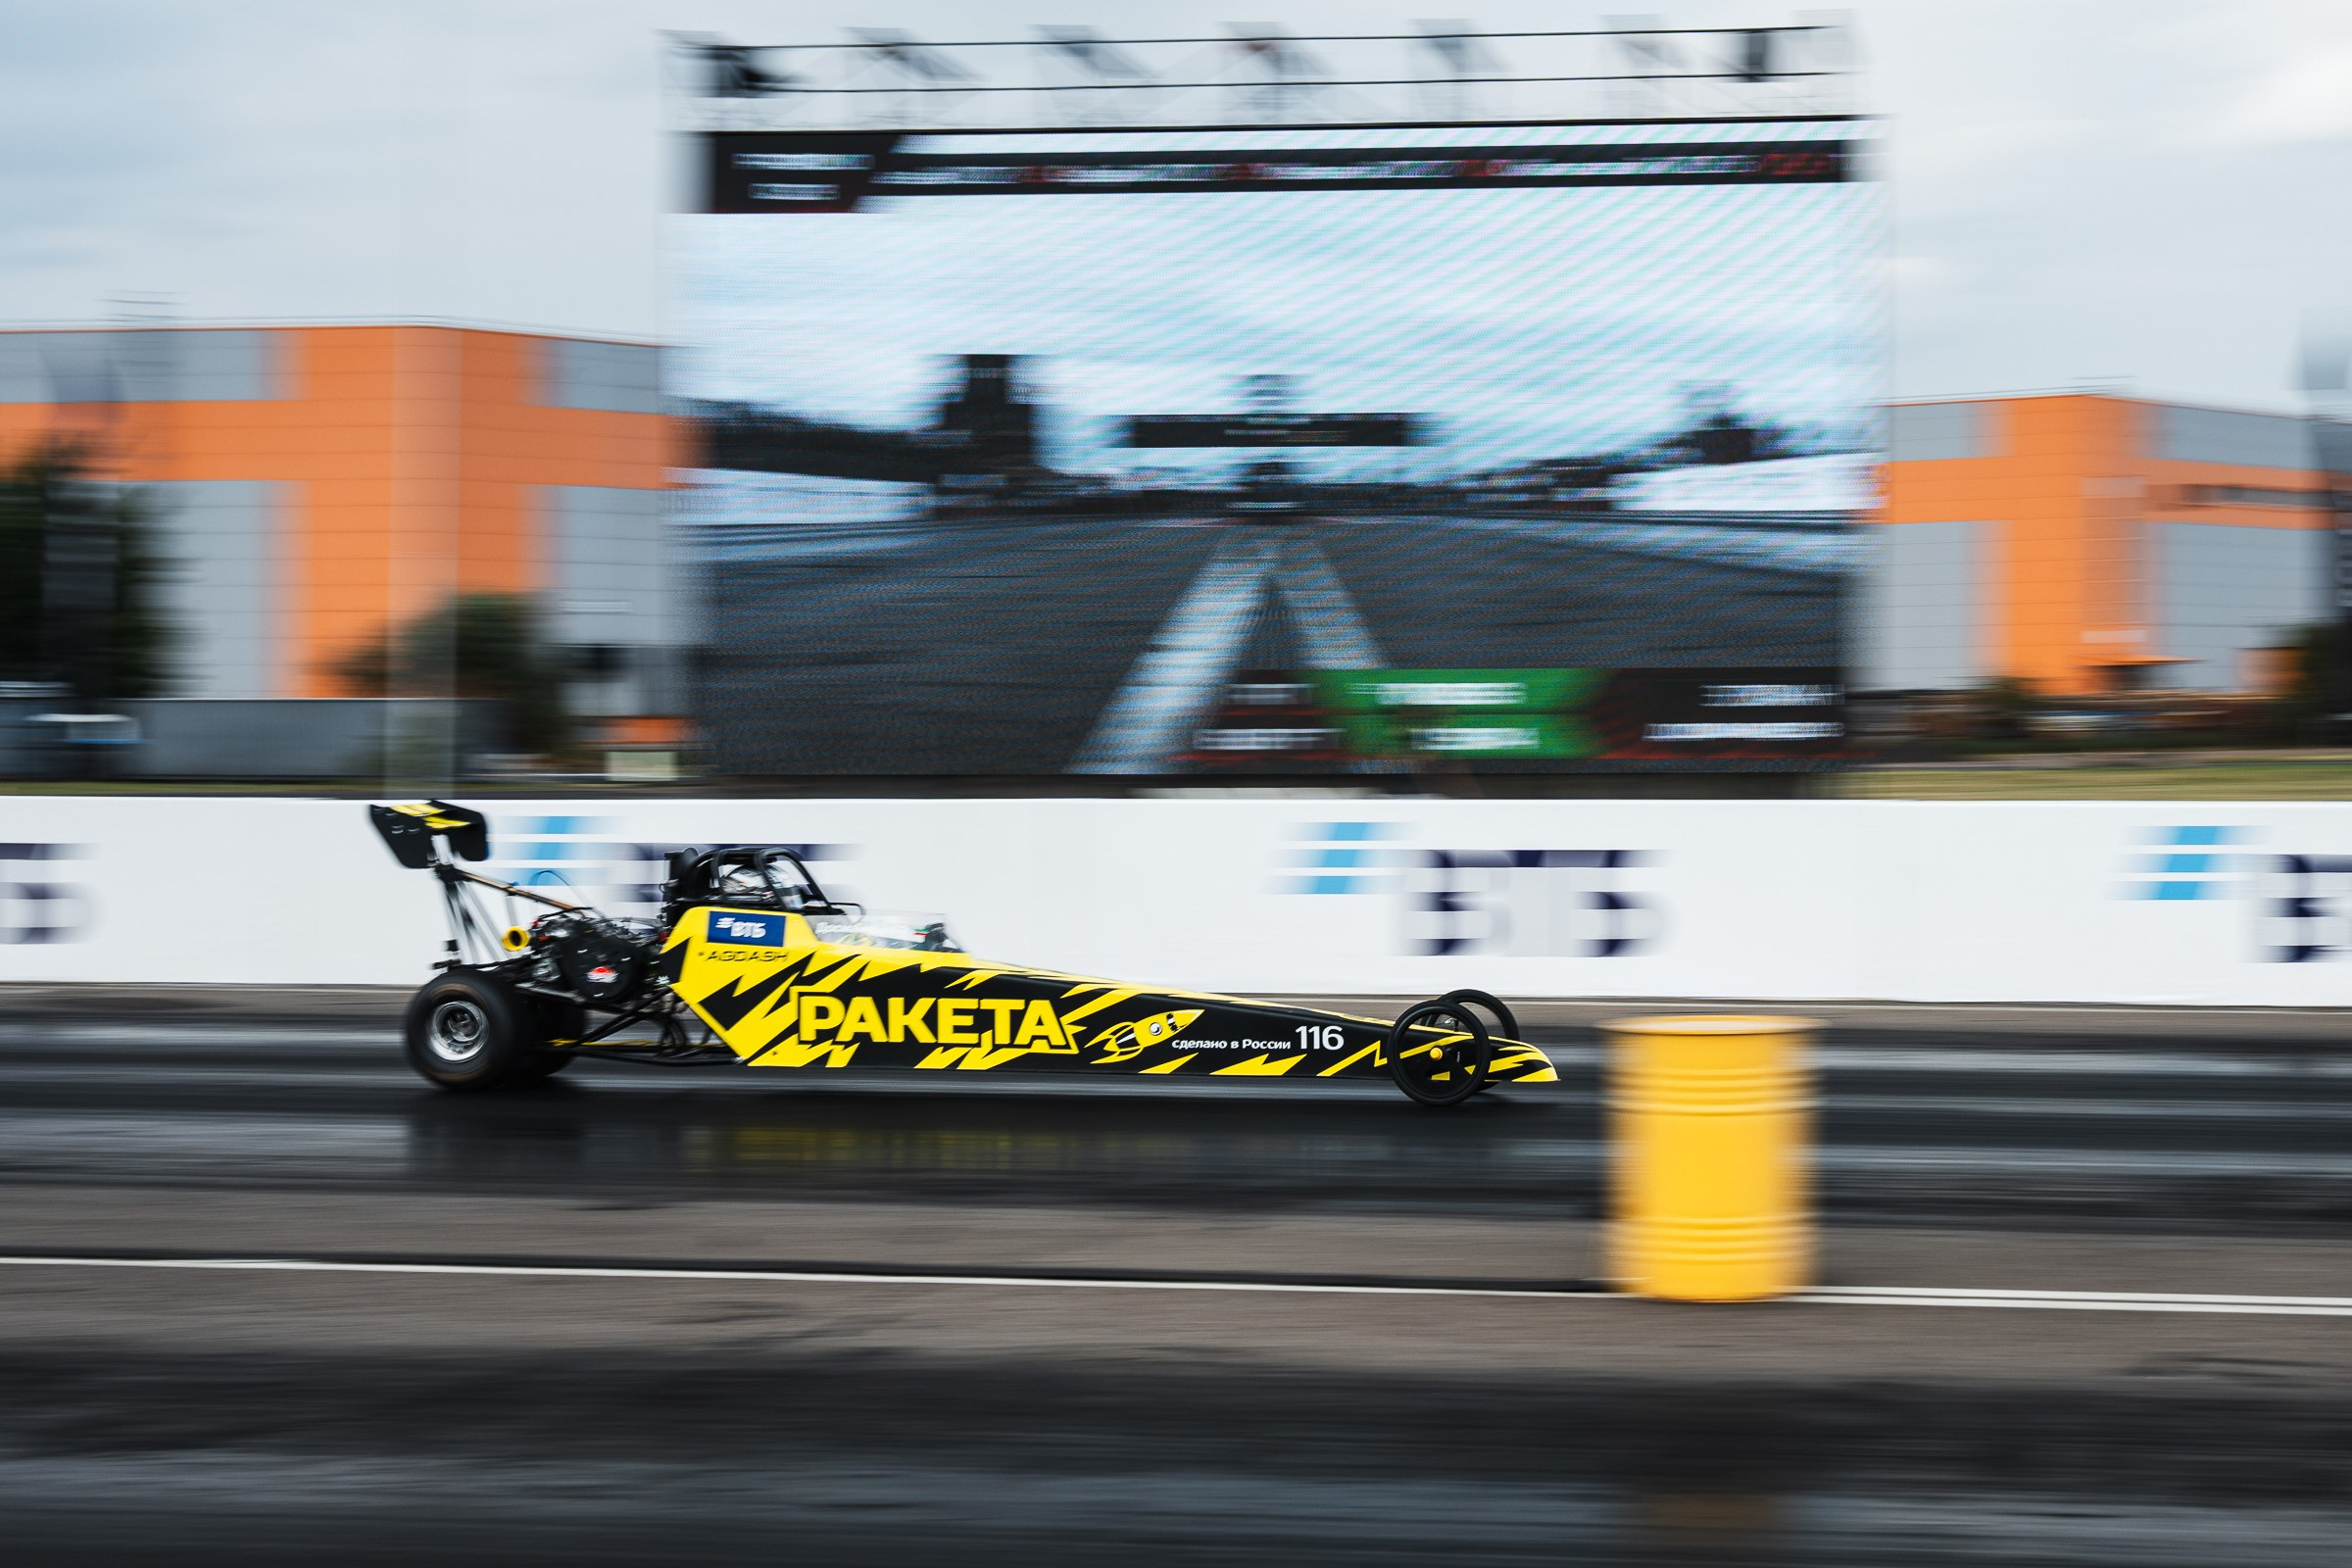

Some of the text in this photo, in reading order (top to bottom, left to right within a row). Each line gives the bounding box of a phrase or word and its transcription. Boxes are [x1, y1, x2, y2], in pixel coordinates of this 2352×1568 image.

[799, 996, 1066, 1046] РАКЕТА
[1171, 1039, 1291, 1050] сделано в России
[1295, 1025, 1345, 1051] 116
